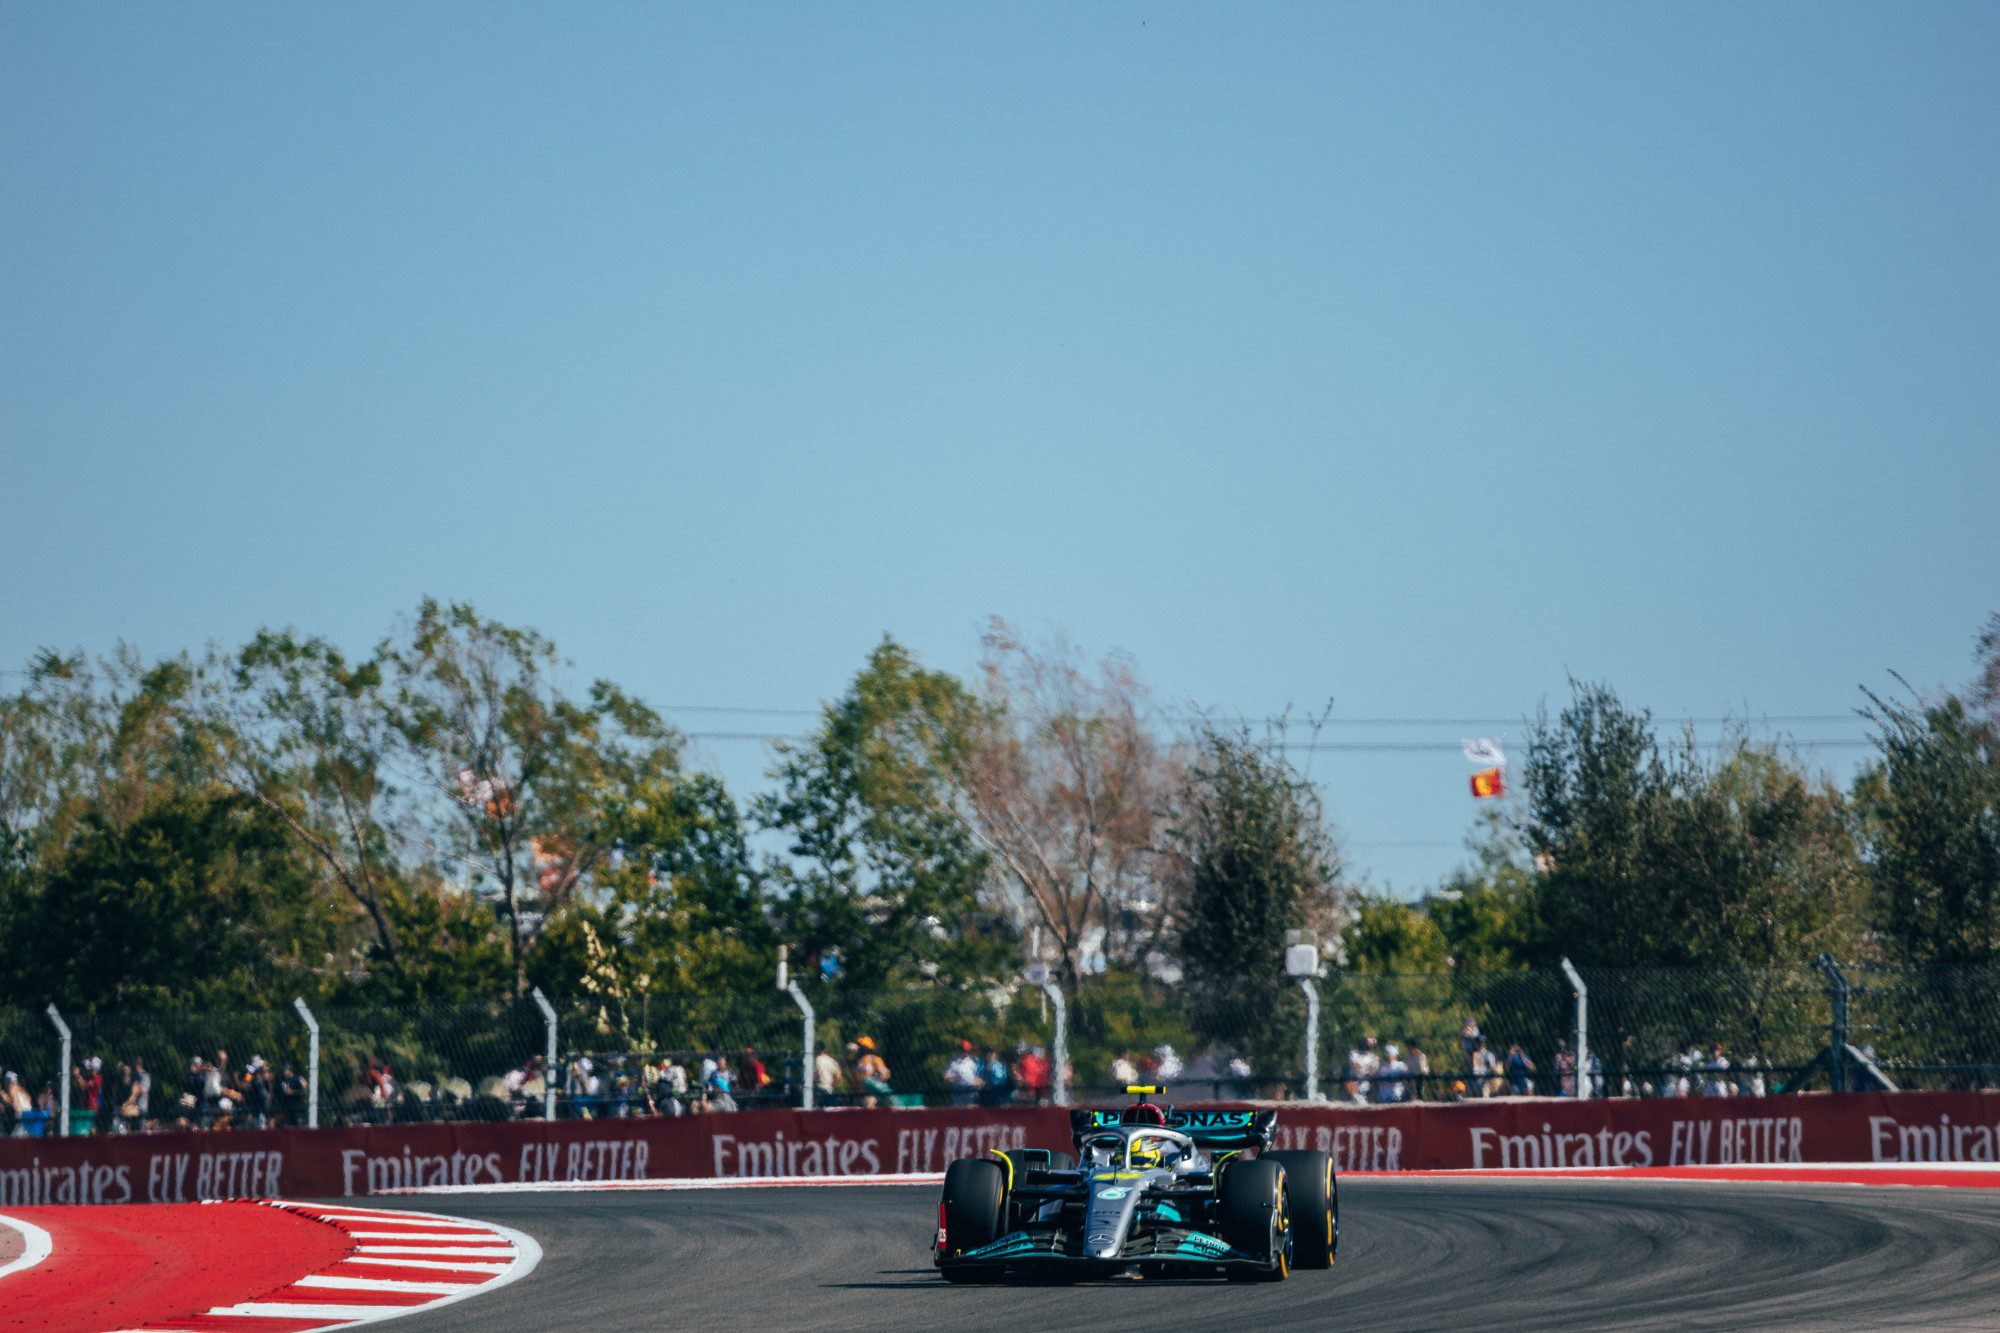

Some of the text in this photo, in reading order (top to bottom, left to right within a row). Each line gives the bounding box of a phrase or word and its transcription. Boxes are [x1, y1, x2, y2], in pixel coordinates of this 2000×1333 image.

[341, 1140, 648, 1196] Emirates FLY BETTER
[712, 1130, 880, 1177] Emirates
[897, 1128, 938, 1173] FLY
[1468, 1117, 1802, 1168] Emirates FLY BETTER
[147, 1153, 189, 1203] FLY
[197, 1151, 282, 1200] BETTER
